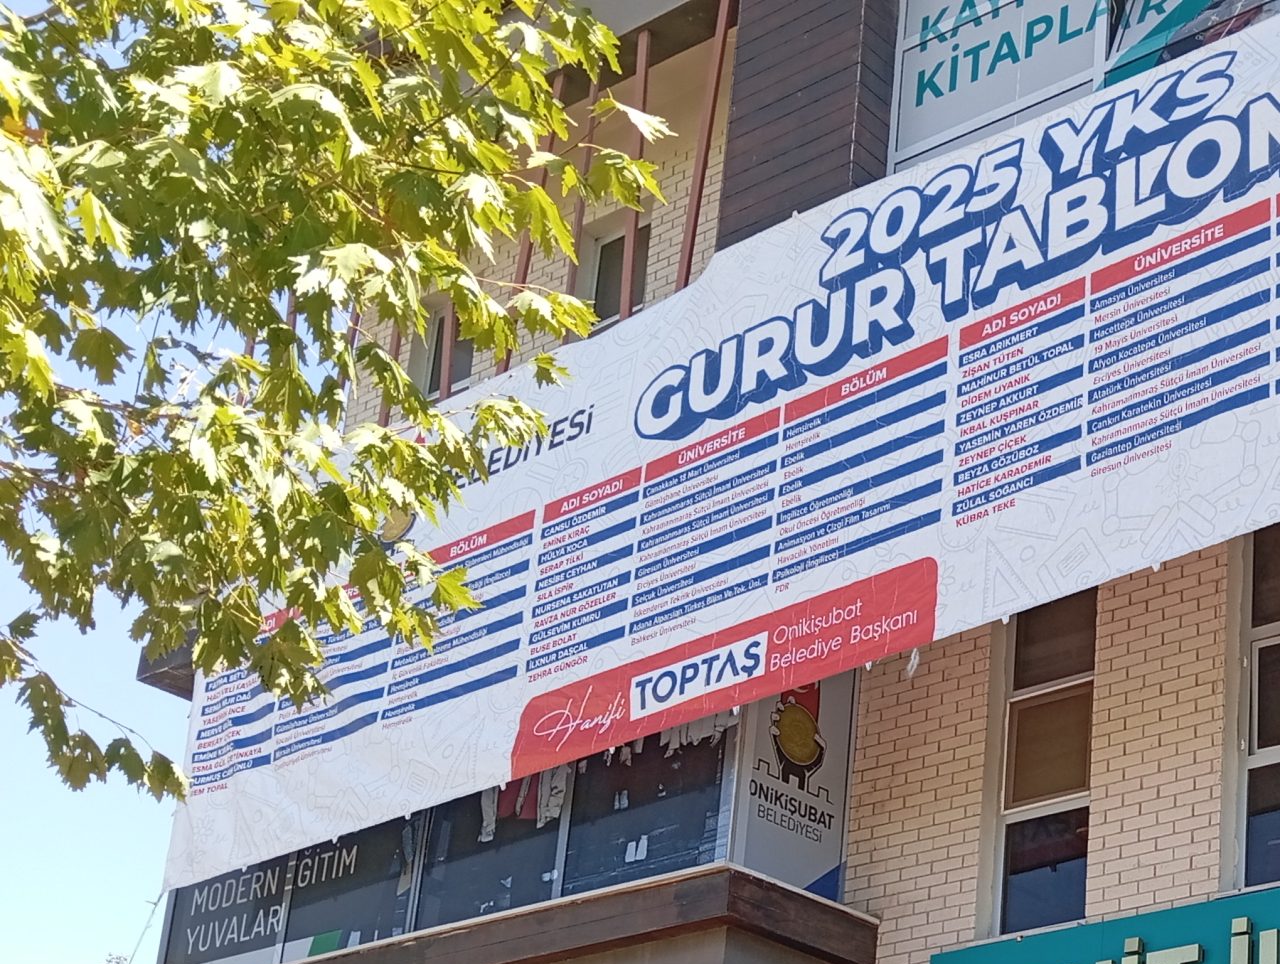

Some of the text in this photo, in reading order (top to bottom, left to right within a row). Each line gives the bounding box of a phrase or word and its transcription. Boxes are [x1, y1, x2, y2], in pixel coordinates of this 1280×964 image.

[820, 51, 1238, 284] 2025 YKS
[1134, 224, 1224, 271] ÜNİVERSİTE
[1094, 270, 1176, 310] Amasya Üniversitesi
[1094, 287, 1170, 325] Mersin Üniversitesi
[982, 294, 1062, 337] ADI SOYADI
[1094, 296, 1184, 340] Hacettepe Üniversitesi
[1105, 336, 1128, 351] Mayıs
[1130, 314, 1178, 340] Üniversitesi
[635, 266, 914, 439] GURUR
[962, 327, 1038, 364] ESRA ARIKMERT
[962, 347, 1024, 378] ZİŞAN TÜTEN
[1093, 317, 1206, 370] Afyon Kocatepe Üniversitesi
[841, 368, 887, 396] BÖLÜM
[962, 342, 1074, 393] MAHİNUR BETÜL TOPAL
[1092, 342, 1262, 414] Kahramanmaraş Sütçü İmam Üniversitesi
[1092, 362, 1172, 400] Atatürk Üniversitesi
[1093, 348, 1171, 385] Erciyes Üniversitesi
[960, 385, 1038, 420] ZEYNEP AKKURT
[962, 374, 1030, 408] DİDEM UYANIK
[1092, 378, 1212, 431] Çankırı Karatekin Üniversitesi
[1092, 374, 1262, 446] Kahramanmaraş Sütçü İmam Üniversitesi
[960, 400, 1039, 438] İKBAL KUŞPINAR
[960, 430, 1002, 452] YASEMİN
[1004, 416, 1036, 436] YAREN
[678, 428, 746, 464] ÜNİVERSİTE
[958, 435, 1026, 468] ZEYNEP ÇİÇEK
[1090, 440, 1172, 478] Giresun Üniversitesi
[1091, 420, 1182, 462] Gaziantep Üniversitesi
[958, 445, 1039, 482] BEYZA GÖZÜBOZ
[958, 455, 1052, 497] HATİCE KARADEMİR
[560, 480, 623, 513] ADI SOYADI
[956, 476, 1034, 513] ZÜLAL SOĞANCI
[956, 498, 1016, 528] KÜBRA TEKE
[450, 534, 488, 557] BÖLÜM
[560, 607, 576, 619] NUR
[773, 599, 864, 645] Onikişubat
[636, 641, 760, 710] TOPTAŞ
[770, 633, 843, 672] Belediye
[850, 609, 918, 646] Başkanı
[749, 778, 834, 830] ONİKİŞUBAT
[758, 804, 822, 843] BELEDİYESİ
[190, 843, 358, 916] MODERN EĞİTİM
